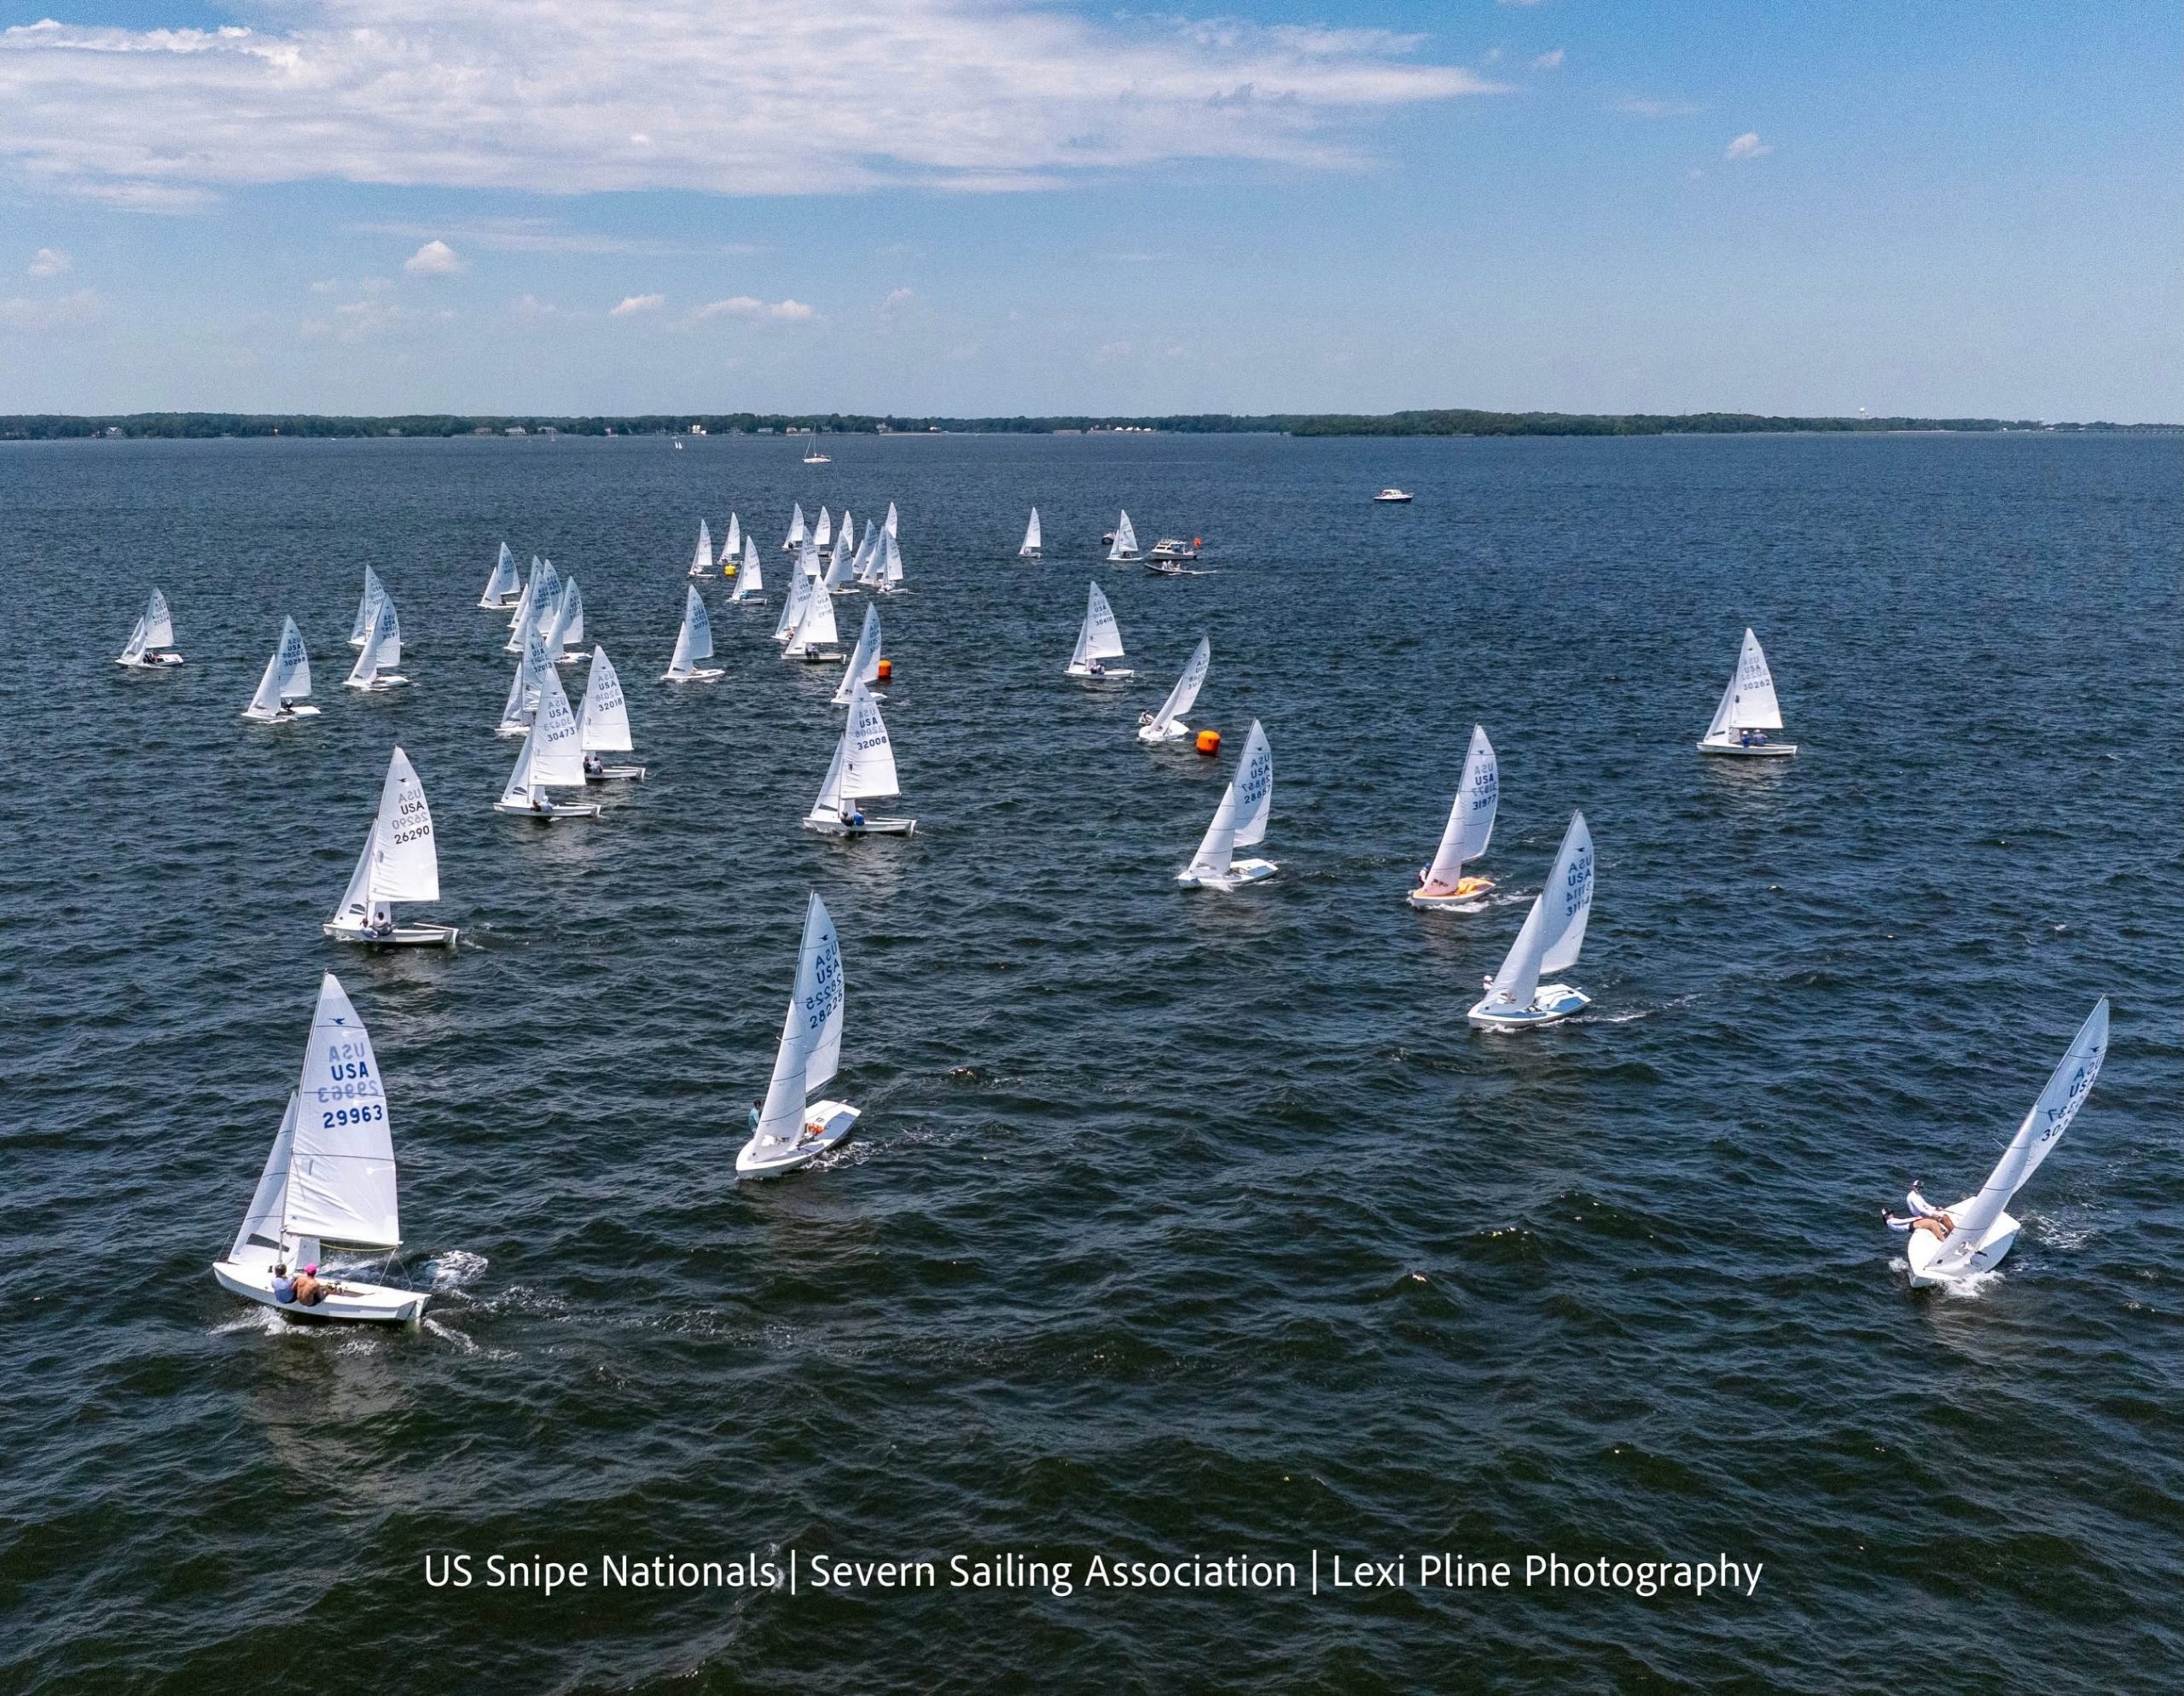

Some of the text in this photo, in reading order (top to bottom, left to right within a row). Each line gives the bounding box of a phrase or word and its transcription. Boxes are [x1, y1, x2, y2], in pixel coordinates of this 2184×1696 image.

[288, 643, 301, 652] USA
[532, 648, 545, 657] USA
[1744, 665, 1762, 674] USA
[598, 680, 617, 691] USA
[549, 707, 569, 718] USA
[859, 717, 879, 728] USA
[547, 727, 575, 742] 30473
[857, 735, 887, 751] 32008
[1251, 764, 1270, 779] USA
[1475, 773, 1495, 786] USA
[400, 800, 425, 816] USA
[1472, 793, 1496, 810] 31977
[394, 825, 430, 845] 26290
[1568, 868, 1592, 886] USA
[816, 958, 840, 984] USA
[810, 990, 843, 1030] 28225
[330, 1061, 369, 1081] USA
[322, 1104, 383, 1130] 29963
